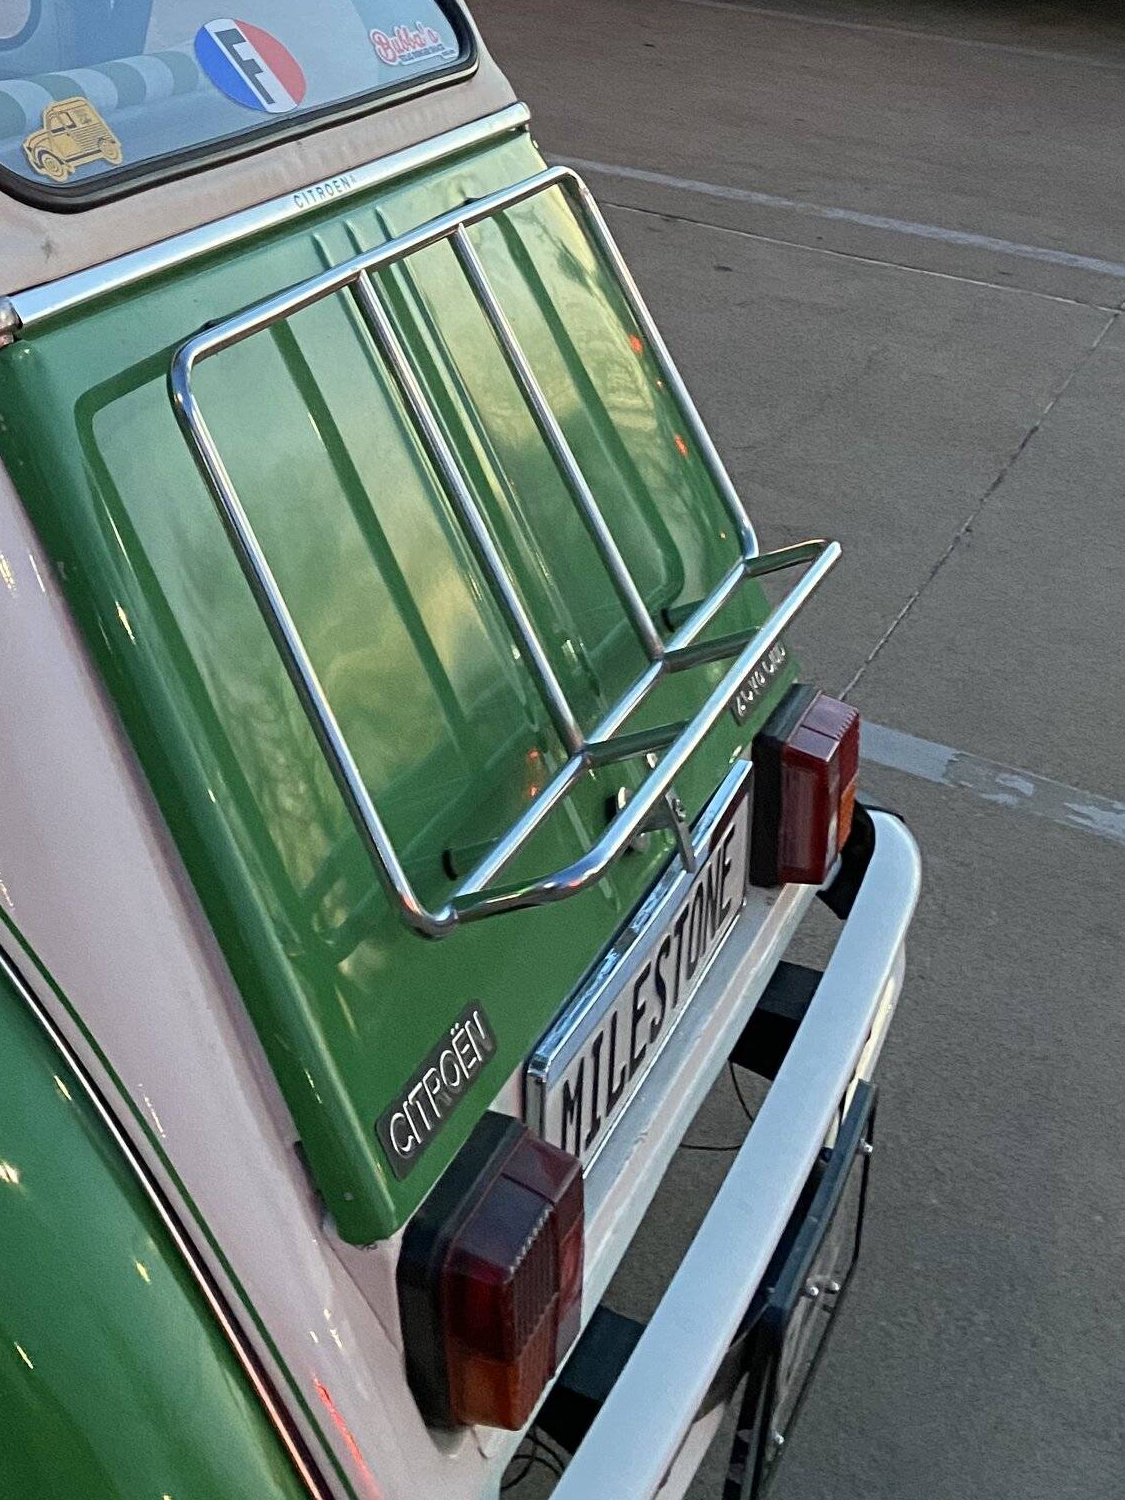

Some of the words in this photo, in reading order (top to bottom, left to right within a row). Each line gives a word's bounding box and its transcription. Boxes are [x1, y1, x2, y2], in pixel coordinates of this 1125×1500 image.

[214, 28, 276, 105] F
[561, 822, 736, 1158] MILESTONE
[390, 1011, 493, 1159] CITROËN
